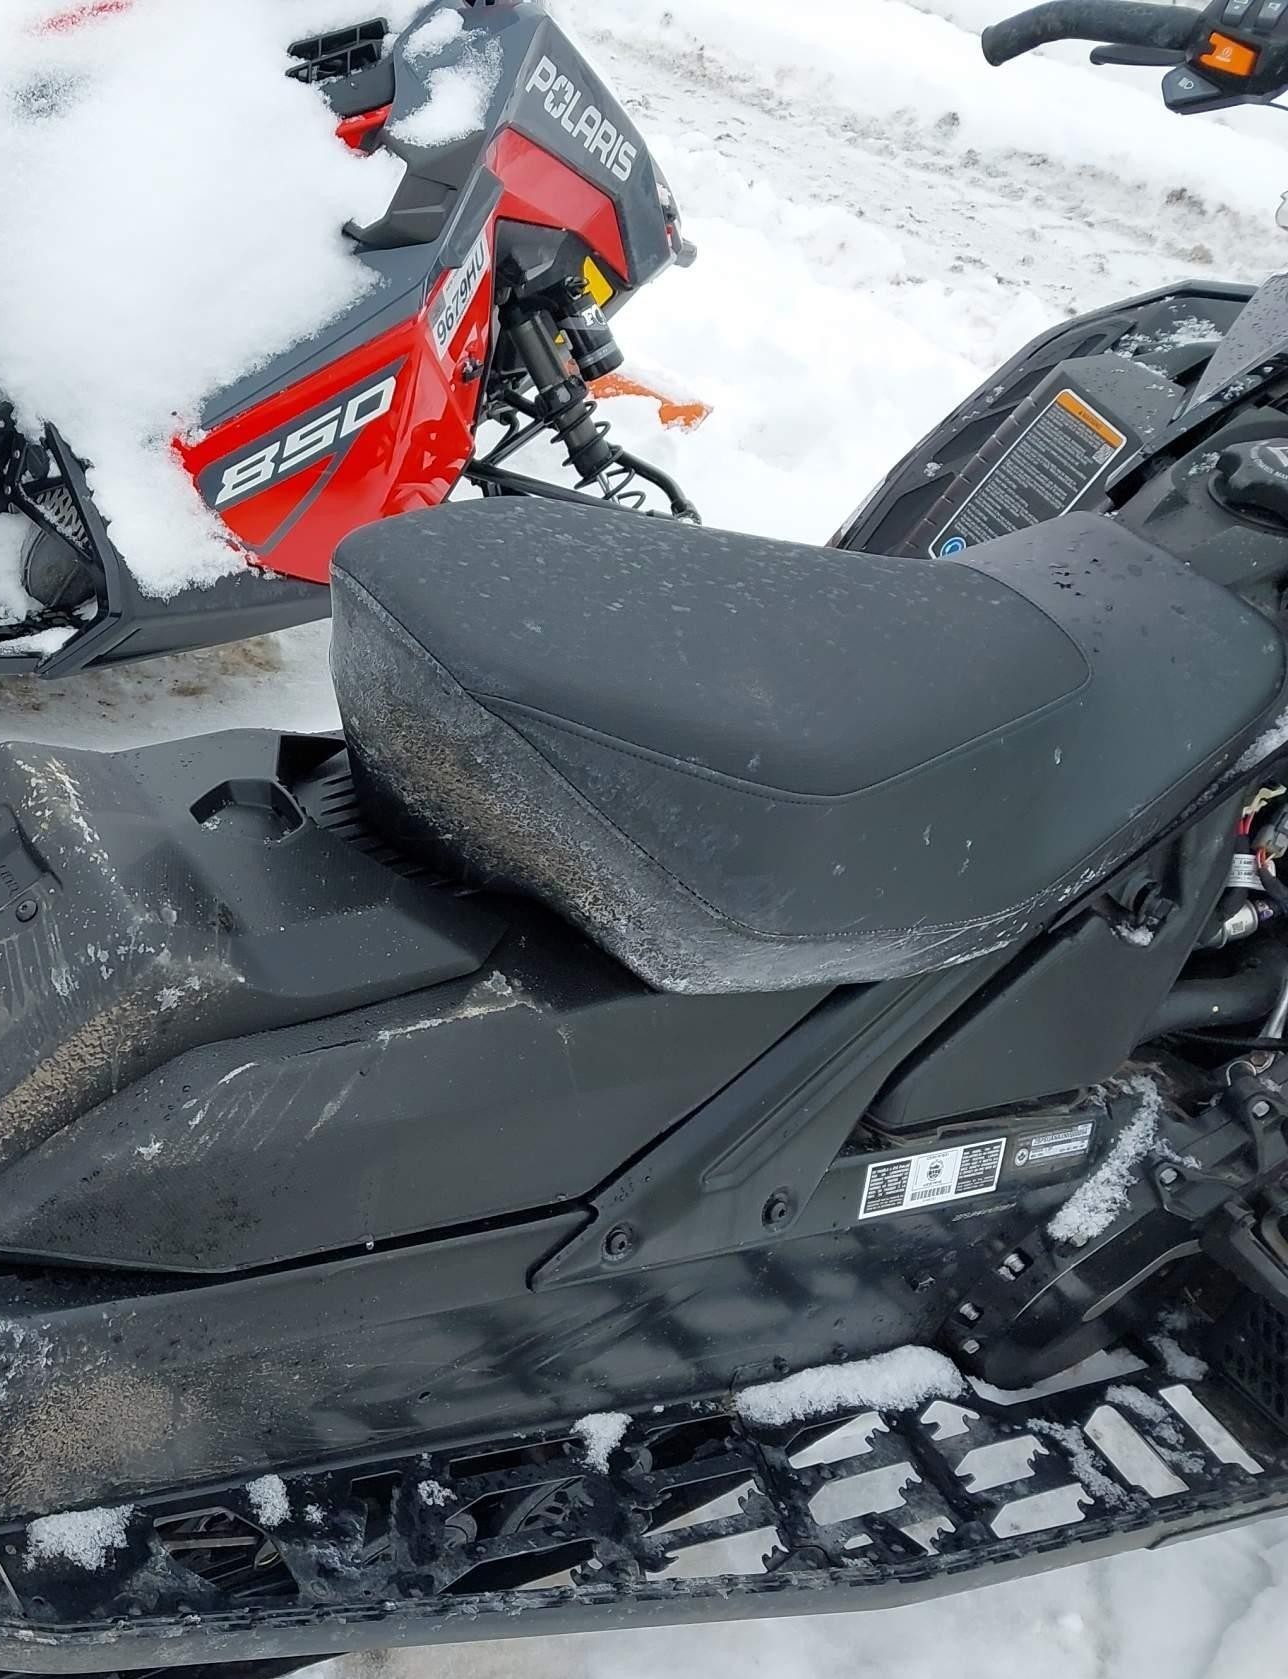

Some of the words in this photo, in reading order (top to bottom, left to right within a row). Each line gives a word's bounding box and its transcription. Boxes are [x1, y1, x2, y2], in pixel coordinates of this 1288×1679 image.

[525, 55, 637, 183] POLARIS
[437, 241, 484, 346] 9679HU
[215, 375, 397, 505] 850
